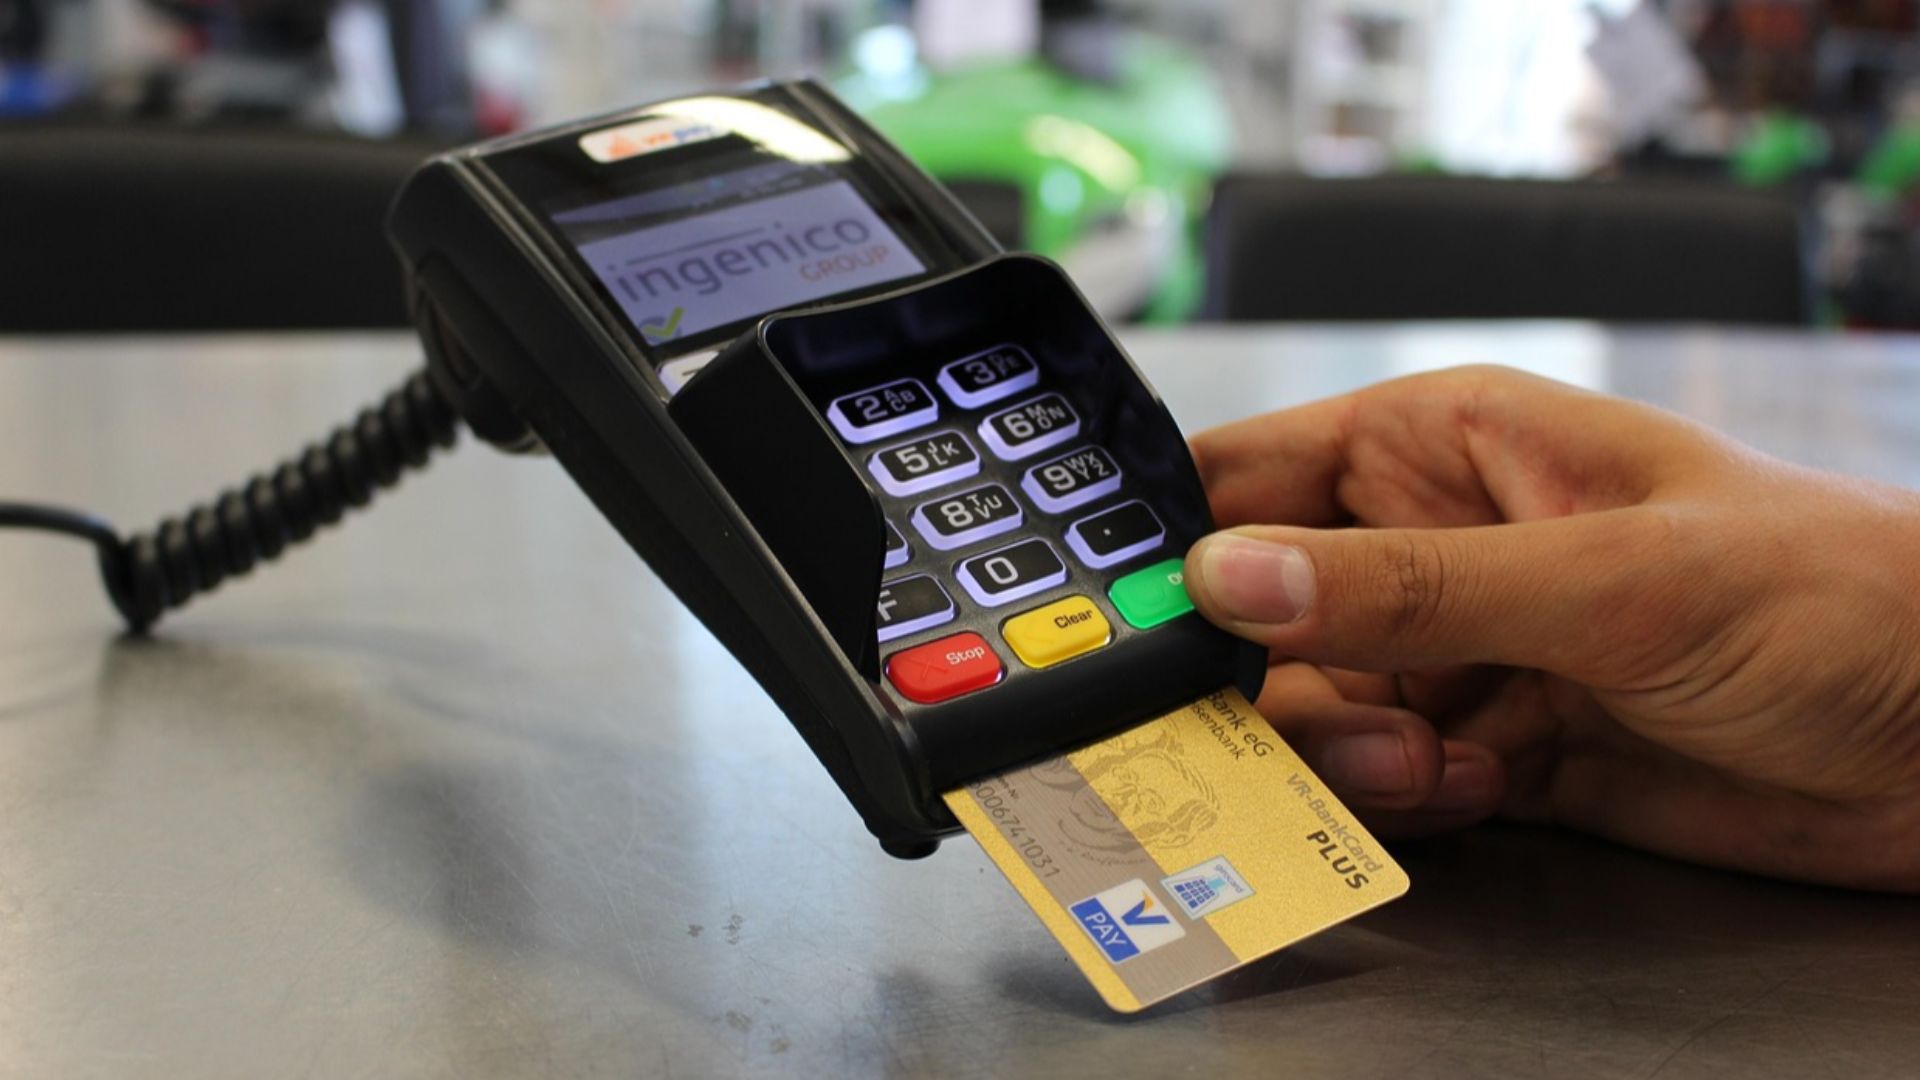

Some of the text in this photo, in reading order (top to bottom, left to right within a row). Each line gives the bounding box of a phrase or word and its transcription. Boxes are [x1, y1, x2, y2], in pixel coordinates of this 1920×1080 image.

[607, 217, 870, 301] ingenico
[799, 246, 892, 283] GROUP
[965, 361, 996, 384] 3
[855, 395, 888, 421] 2
[1003, 412, 1035, 438] 6
[895, 446, 930, 473] 5
[1043, 465, 1076, 491] 9
[940, 501, 974, 528] 8
[878, 589, 897, 622] F
[1054, 609, 1094, 629] Clear
[945, 645, 985, 665] Stop
[1243, 732, 1274, 758] eG
[1287, 773, 1384, 873] VR-BankCard
[1306, 829, 1370, 890] PLUS
[1084, 911, 1127, 947] PAY
